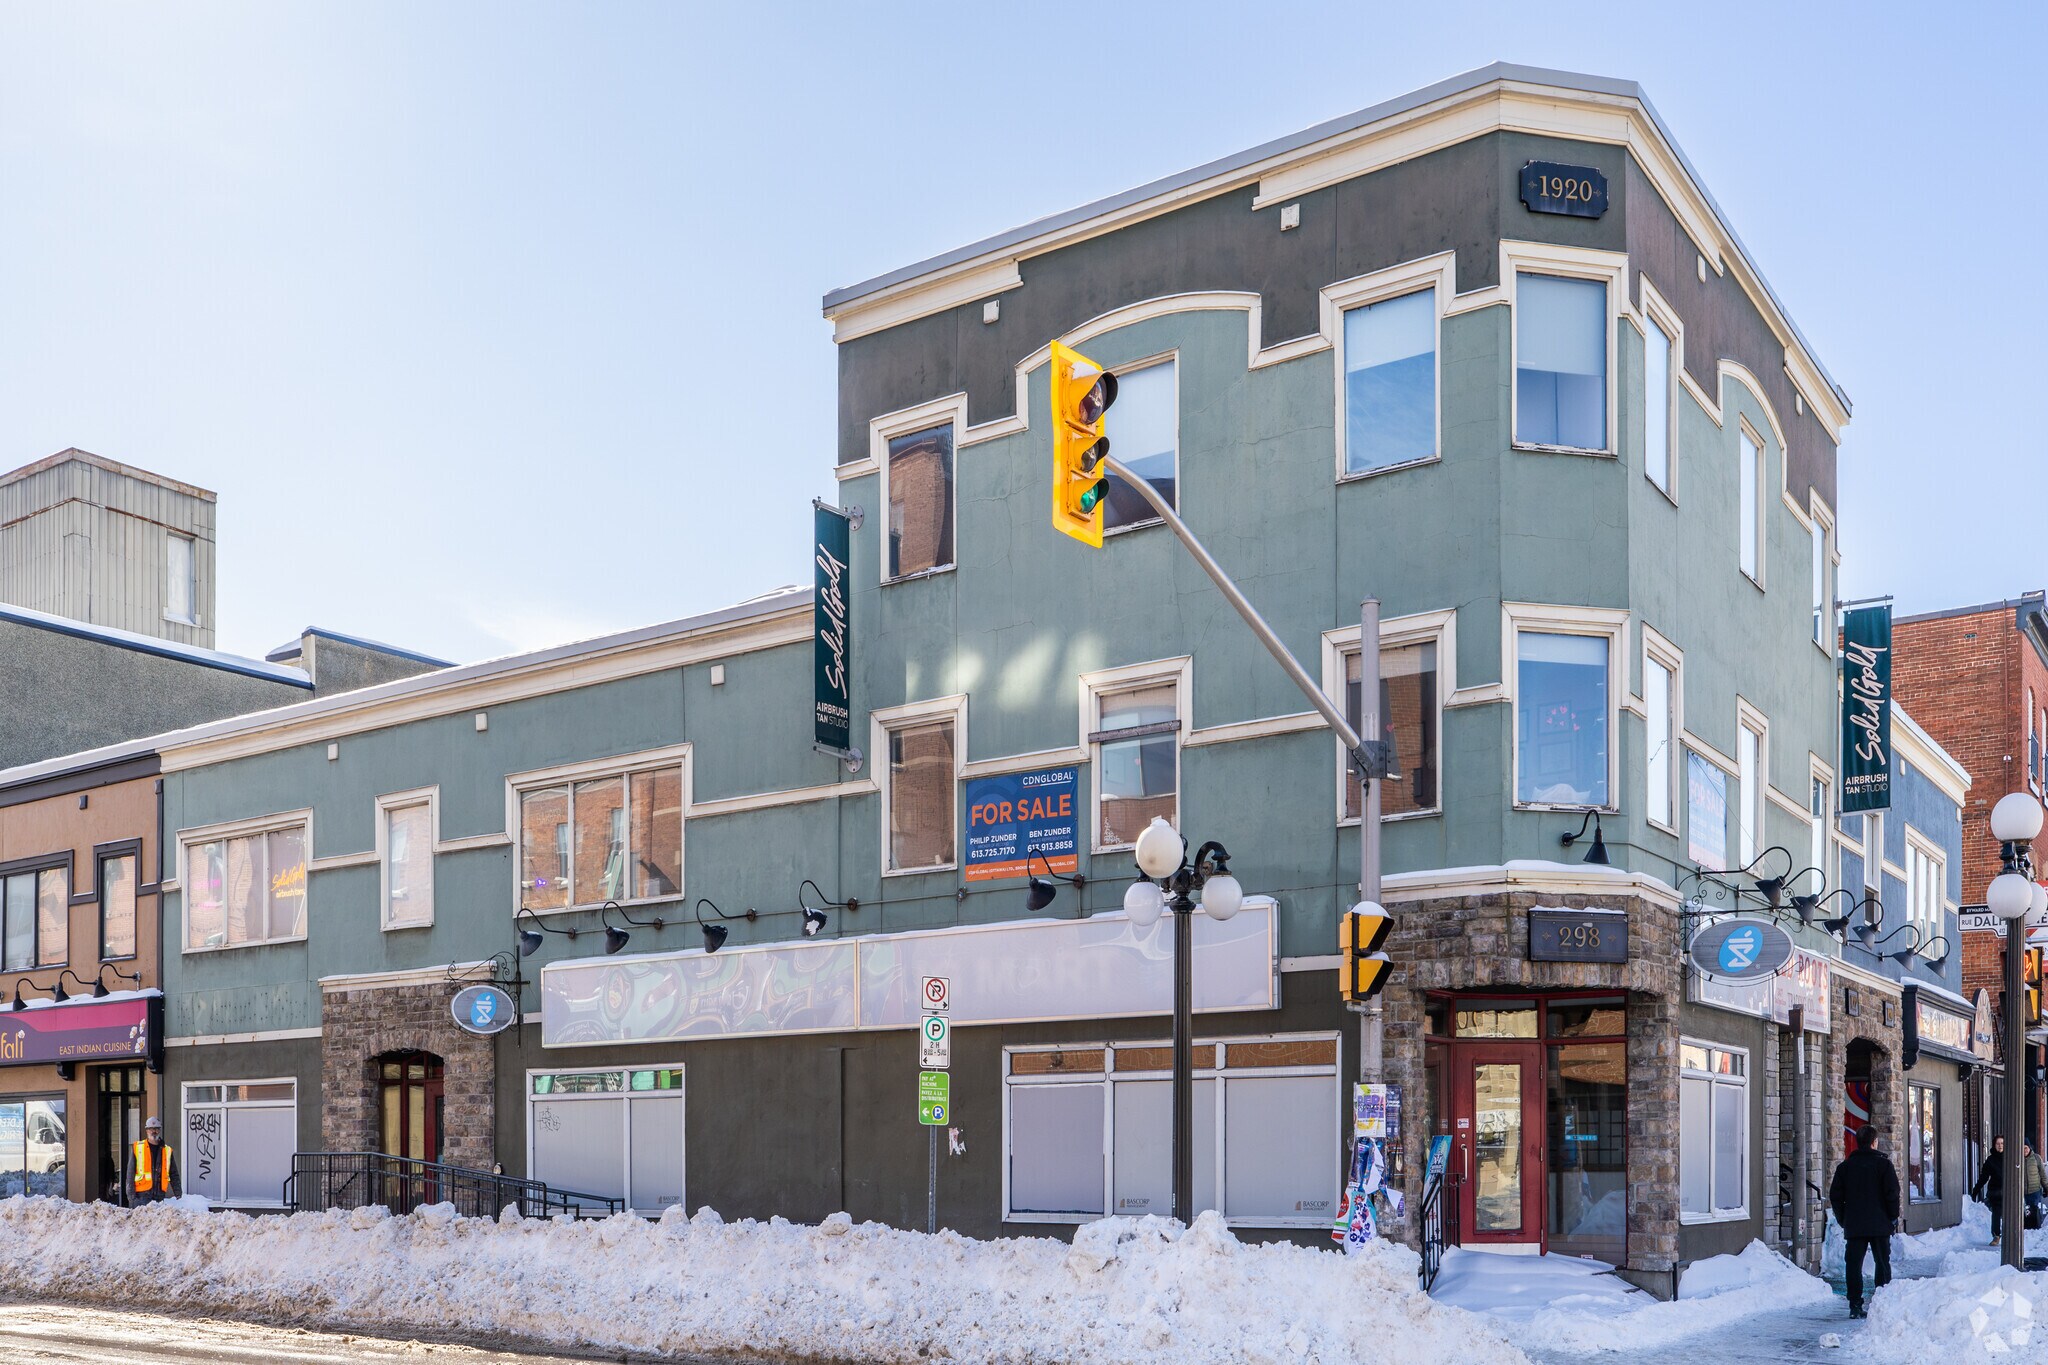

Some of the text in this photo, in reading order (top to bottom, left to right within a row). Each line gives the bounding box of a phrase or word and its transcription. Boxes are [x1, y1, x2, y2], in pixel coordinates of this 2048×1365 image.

[1539, 175, 1593, 202] 1920
[816, 701, 849, 719] AIRBRUSH
[816, 712, 849, 729] TAN STUDIO
[1022, 771, 1074, 786] CDNGLOBAL
[1845, 773, 1888, 786] AIRBRUSH
[1845, 783, 1889, 795] TAN STUDIO
[971, 794, 1071, 827] FOR SALE
[970, 833, 1017, 845] PHILIP ZUNDER
[1029, 827, 1071, 838] BEN ZUNDER
[971, 846, 1016, 859] 613.725.7170
[1559, 926, 1601, 948] 298
[59, 1041, 132, 1056] EAST INDIAN CUISINE
[1302, 1200, 1330, 1208] BASCORP
